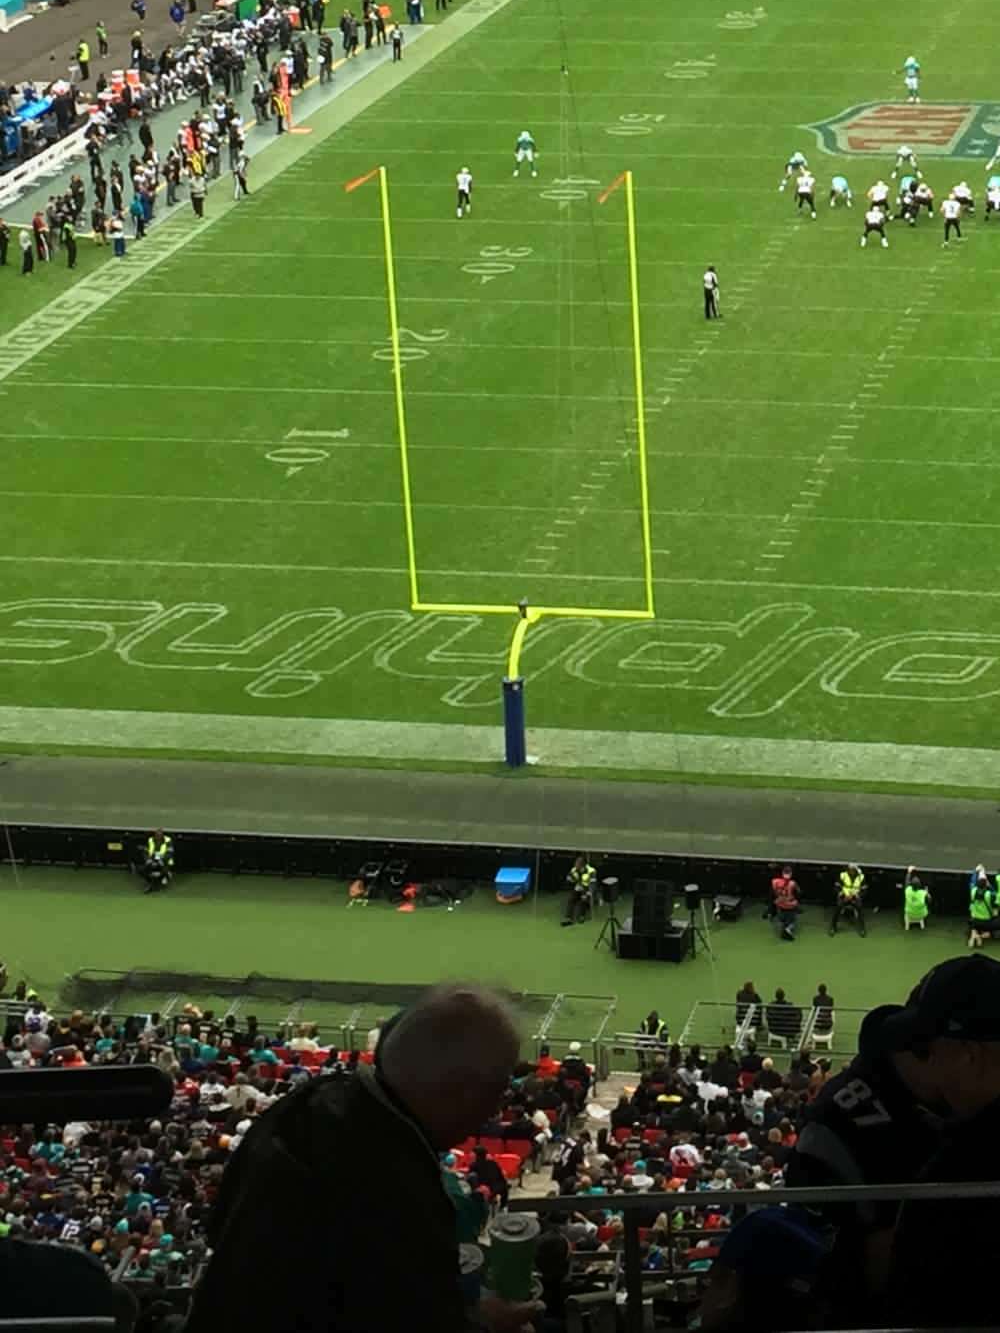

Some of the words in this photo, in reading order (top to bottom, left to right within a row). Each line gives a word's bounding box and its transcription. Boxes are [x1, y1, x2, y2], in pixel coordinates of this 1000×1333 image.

[461, 245, 534, 274] 30
[371, 327, 450, 362] 20
[265, 427, 351, 464] 10
[831, 1077, 893, 1128] 87
